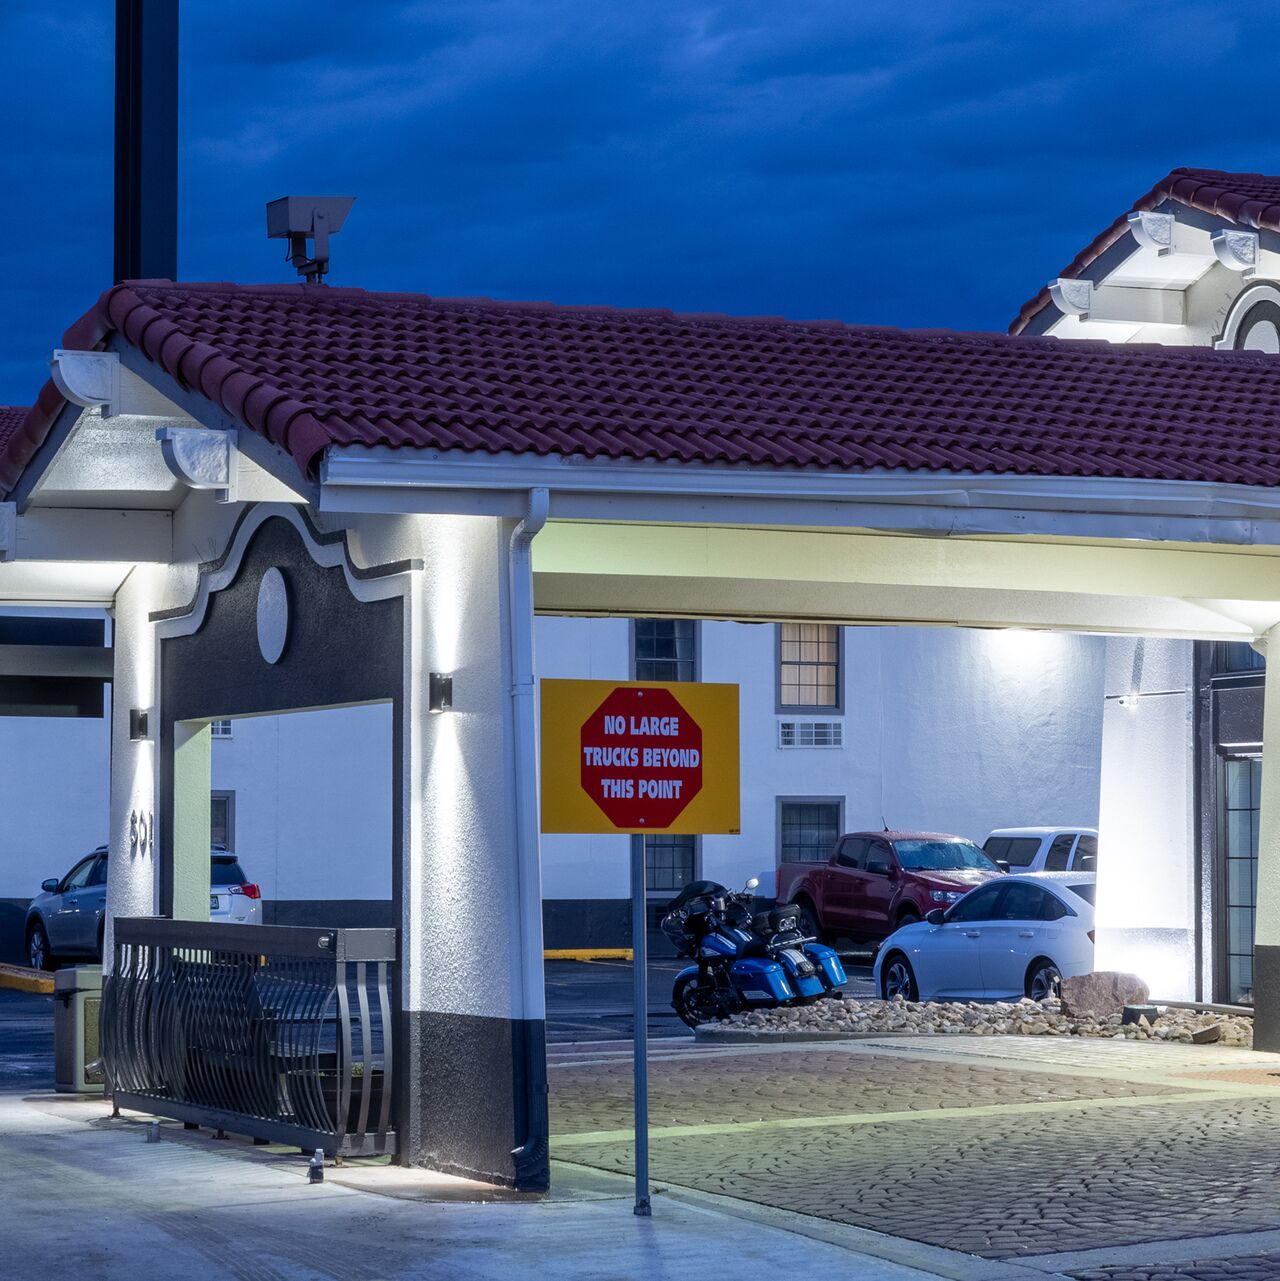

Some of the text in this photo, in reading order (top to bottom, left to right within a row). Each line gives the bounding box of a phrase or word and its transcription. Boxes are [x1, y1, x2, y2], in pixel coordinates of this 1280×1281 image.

[604, 716, 679, 736] NO LARGE
[584, 746, 700, 768] TRUCKS BEYOND
[601, 779, 682, 799] THIS POINT
